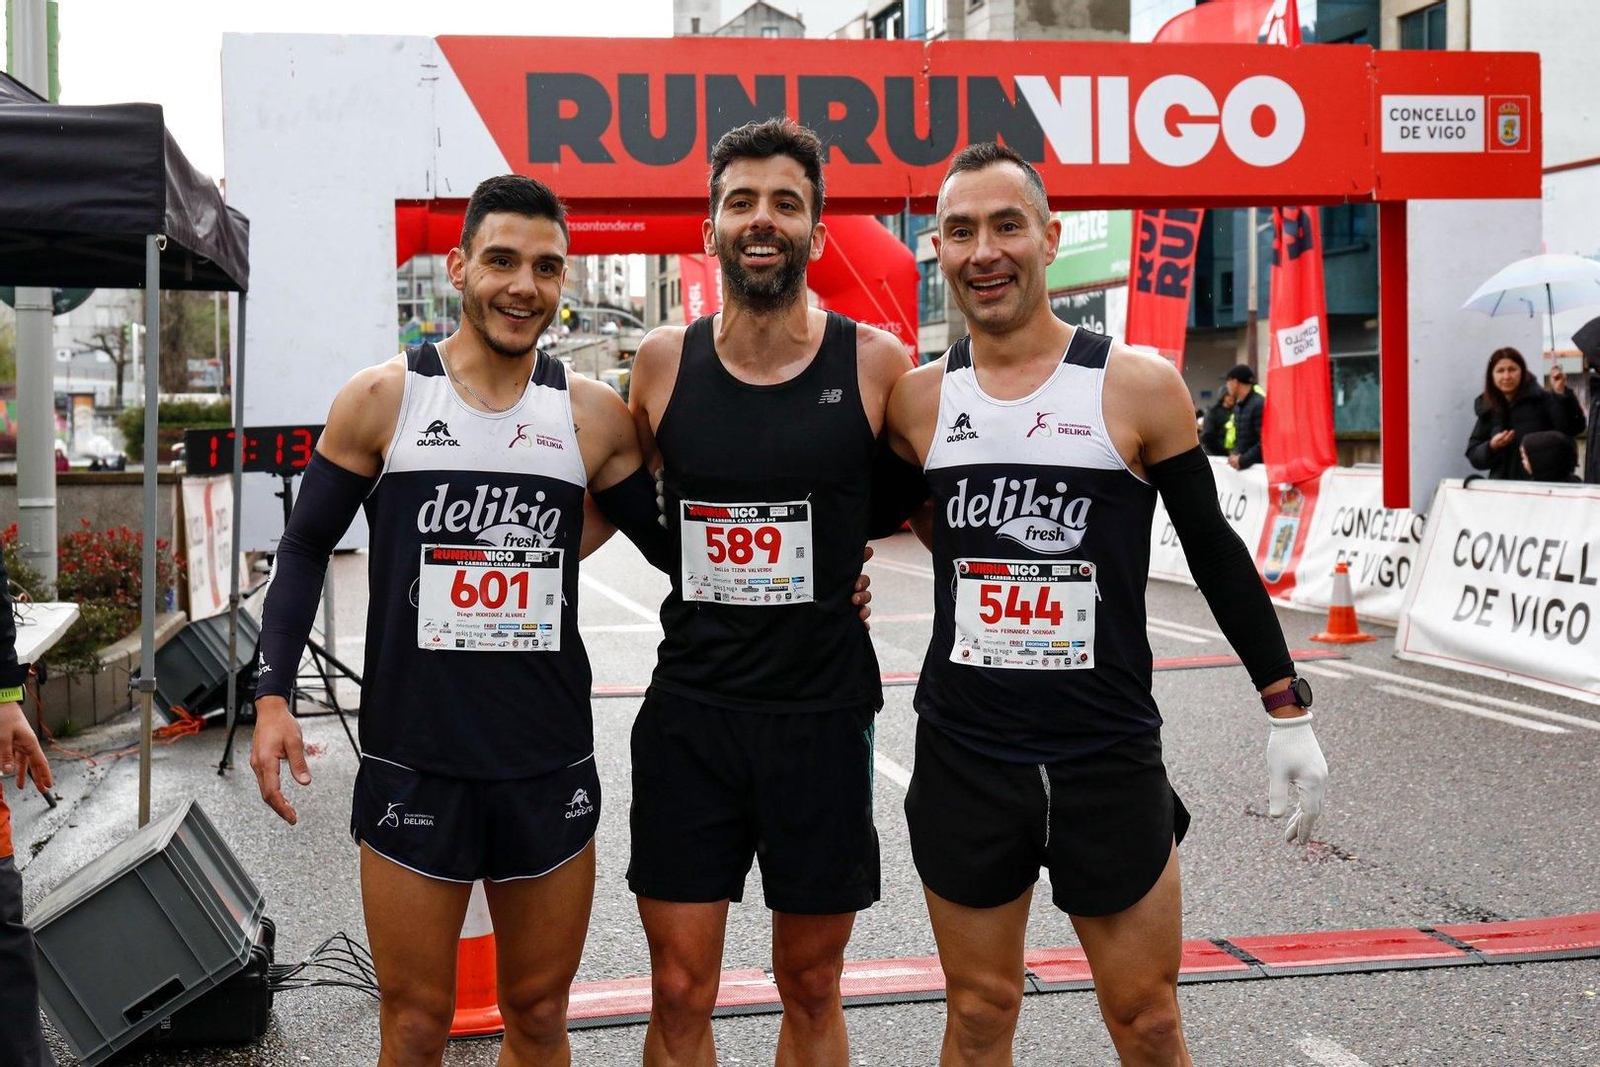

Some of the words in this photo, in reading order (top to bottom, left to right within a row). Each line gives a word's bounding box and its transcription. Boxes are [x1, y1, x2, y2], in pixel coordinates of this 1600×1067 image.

[1390, 108, 1476, 122] CONCELLO
[1400, 126, 1421, 139] DE
[1427, 126, 1467, 139] VIGO
[946, 430, 979, 443] austral
[1058, 427, 1092, 437] DELIKIA
[416, 439, 461, 447] austral
[536, 438, 564, 451] DELIKIA
[416, 482, 562, 538] delikia
[946, 476, 1092, 531] delikia
[1331, 505, 1427, 544] CONCELLO
[503, 532, 541, 548] fresh
[1025, 525, 1066, 542] fresh
[705, 525, 782, 565] 589
[1360, 552, 1411, 590] VIGO
[450, 569, 529, 610] 601
[979, 584, 1064, 626] 544
[1452, 584, 1499, 627] DE
[1511, 592, 1590, 645] VIGO
[404, 818, 435, 826] DELIKIA
